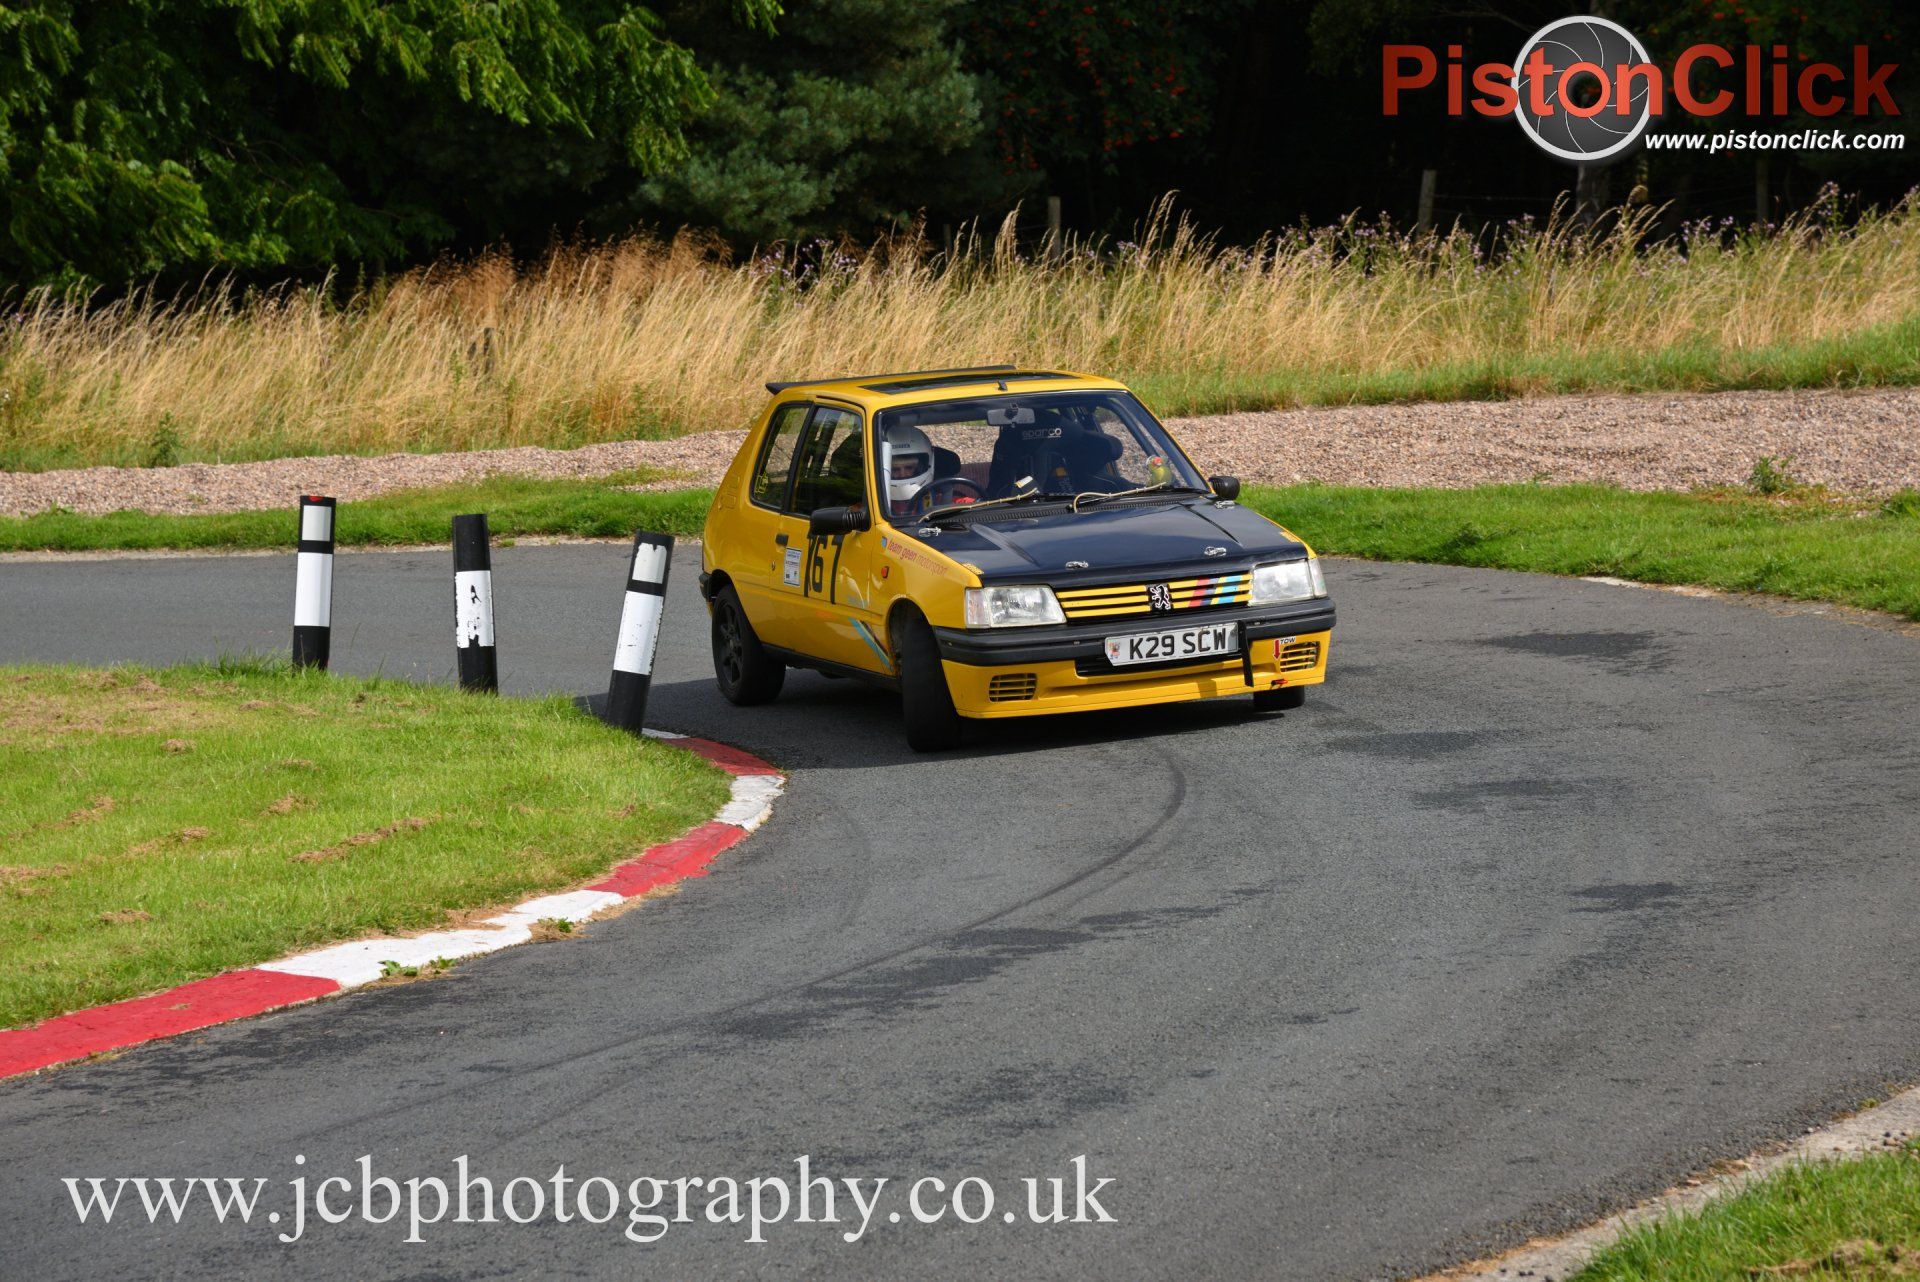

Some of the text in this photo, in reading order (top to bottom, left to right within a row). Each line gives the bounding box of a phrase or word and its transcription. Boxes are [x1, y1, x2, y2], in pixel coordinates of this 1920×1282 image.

[887, 539, 903, 555] team
[916, 554, 948, 576] motorsport
[1129, 627, 1227, 661] K29 SCW
[1280, 636, 1296, 644] TOW
